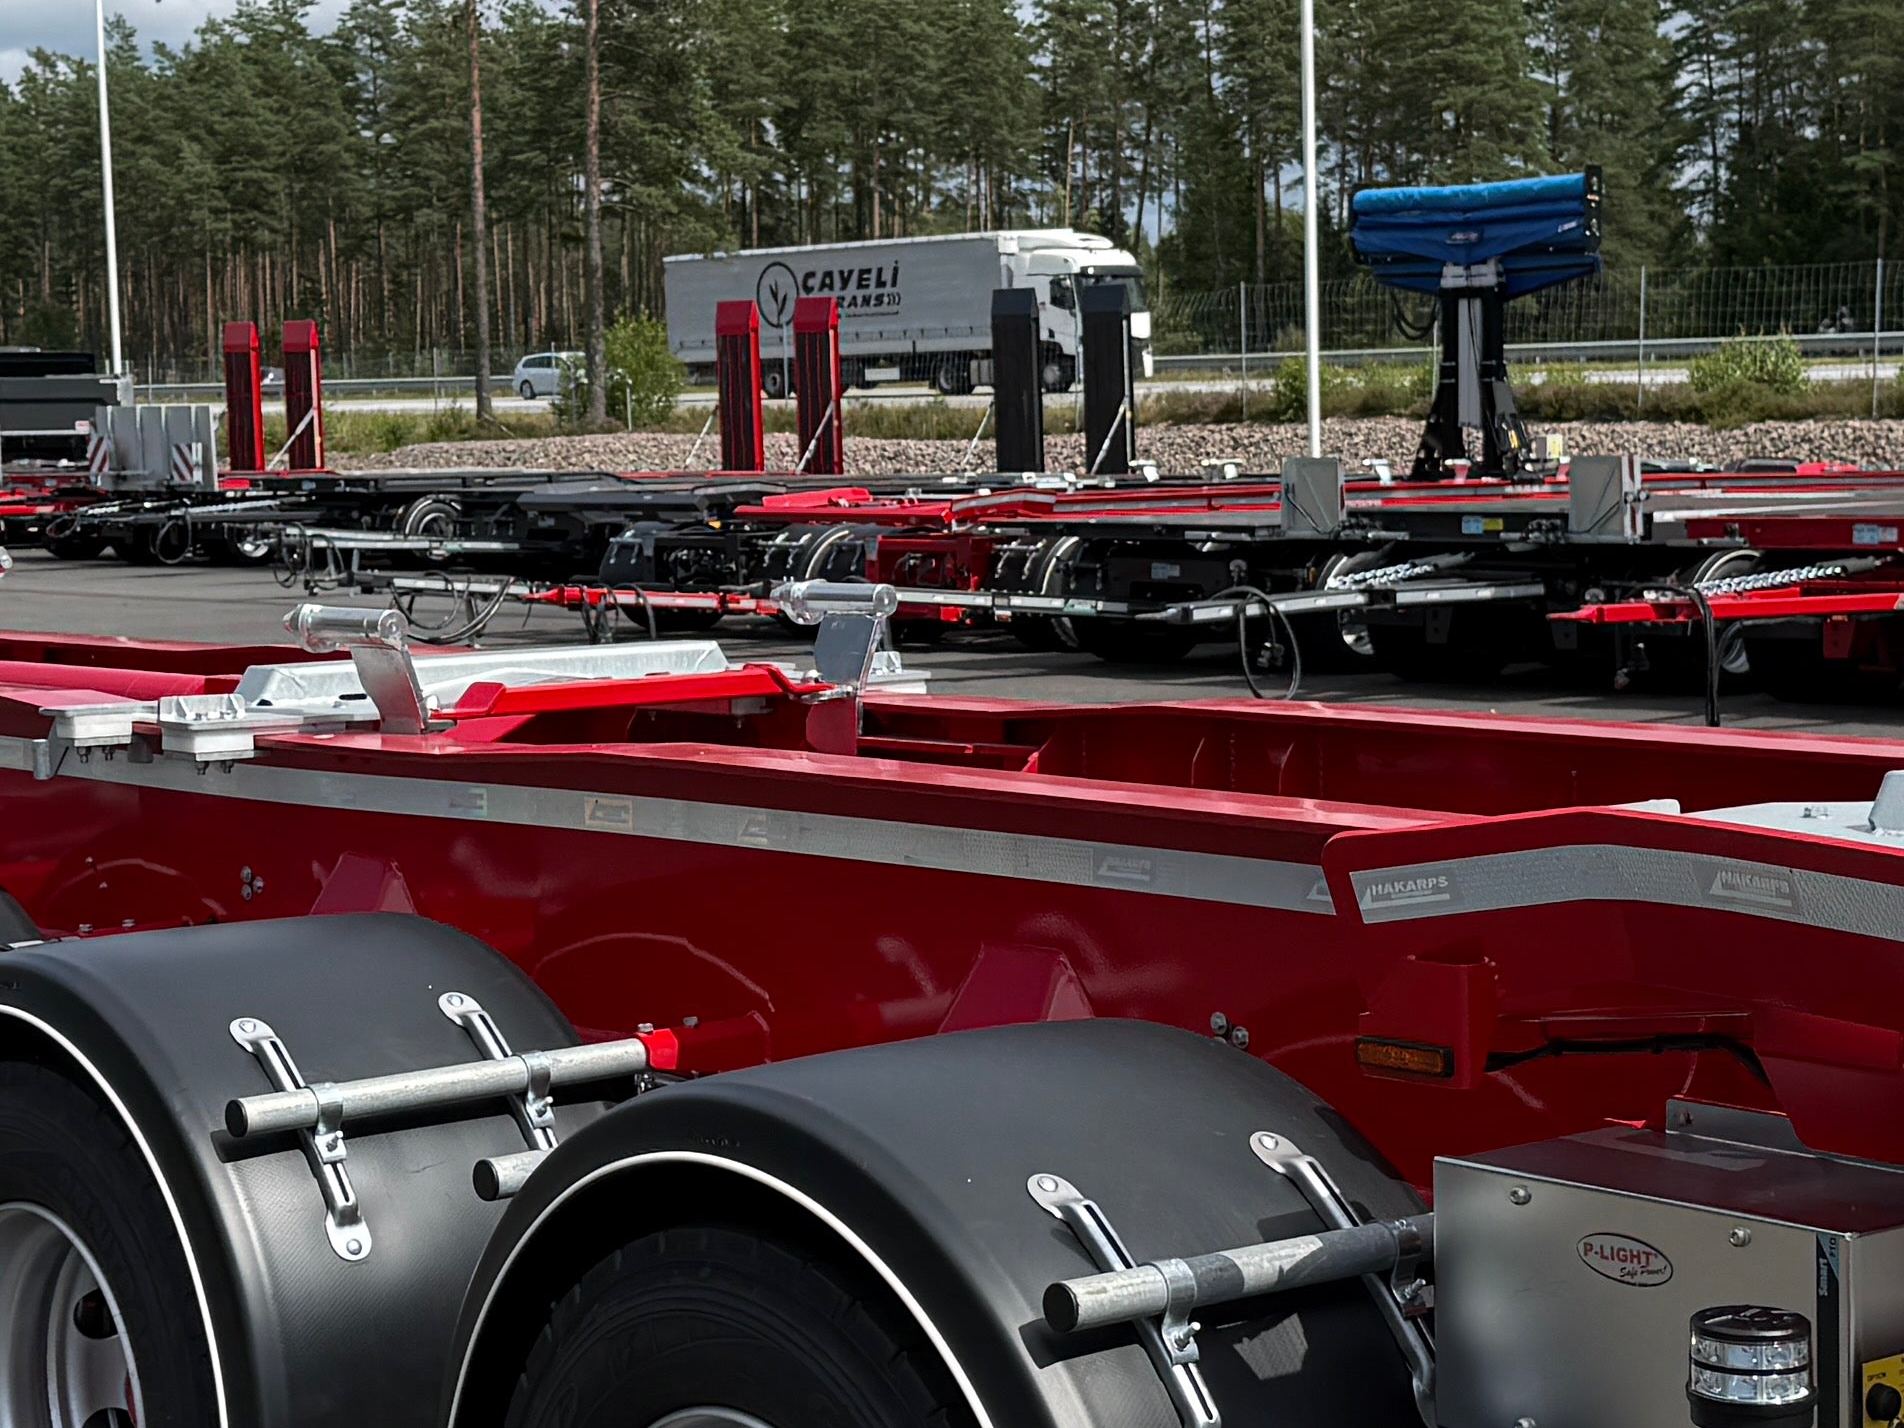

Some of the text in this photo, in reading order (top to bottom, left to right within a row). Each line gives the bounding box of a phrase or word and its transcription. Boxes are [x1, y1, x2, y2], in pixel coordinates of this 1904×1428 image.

[837, 293, 885, 309] RANS
[1371, 875, 1449, 896] HAKARPS
[1583, 1241, 1653, 1266] P-LIGHT
